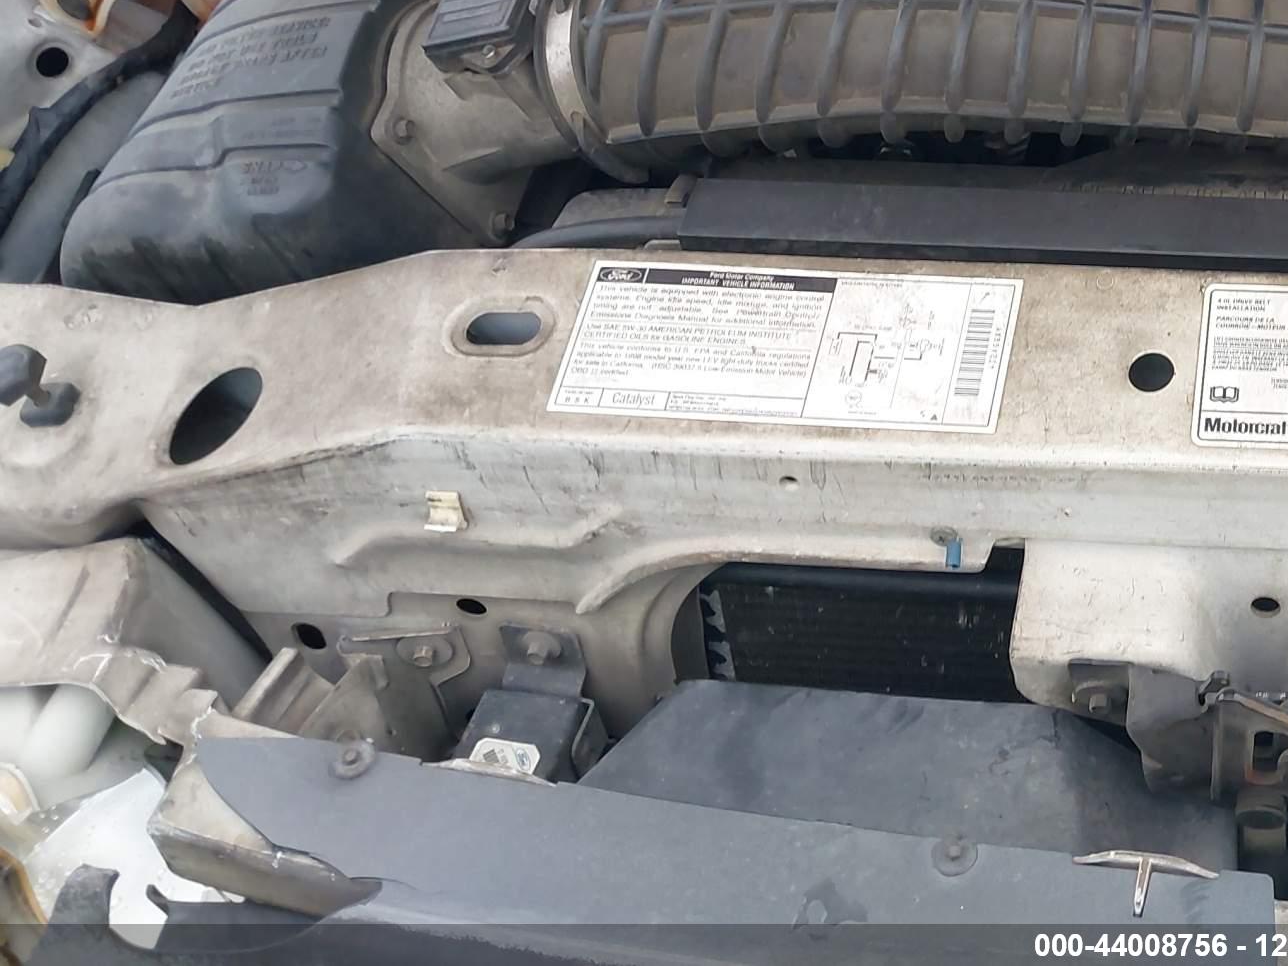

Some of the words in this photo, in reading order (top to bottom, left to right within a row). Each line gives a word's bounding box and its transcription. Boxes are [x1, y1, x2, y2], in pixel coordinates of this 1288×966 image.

[606, 269, 635, 281] Ford
[681, 277, 719, 286] IMPORTANT
[750, 282, 795, 290] INFORMATION
[612, 392, 656, 409] Catalyst
